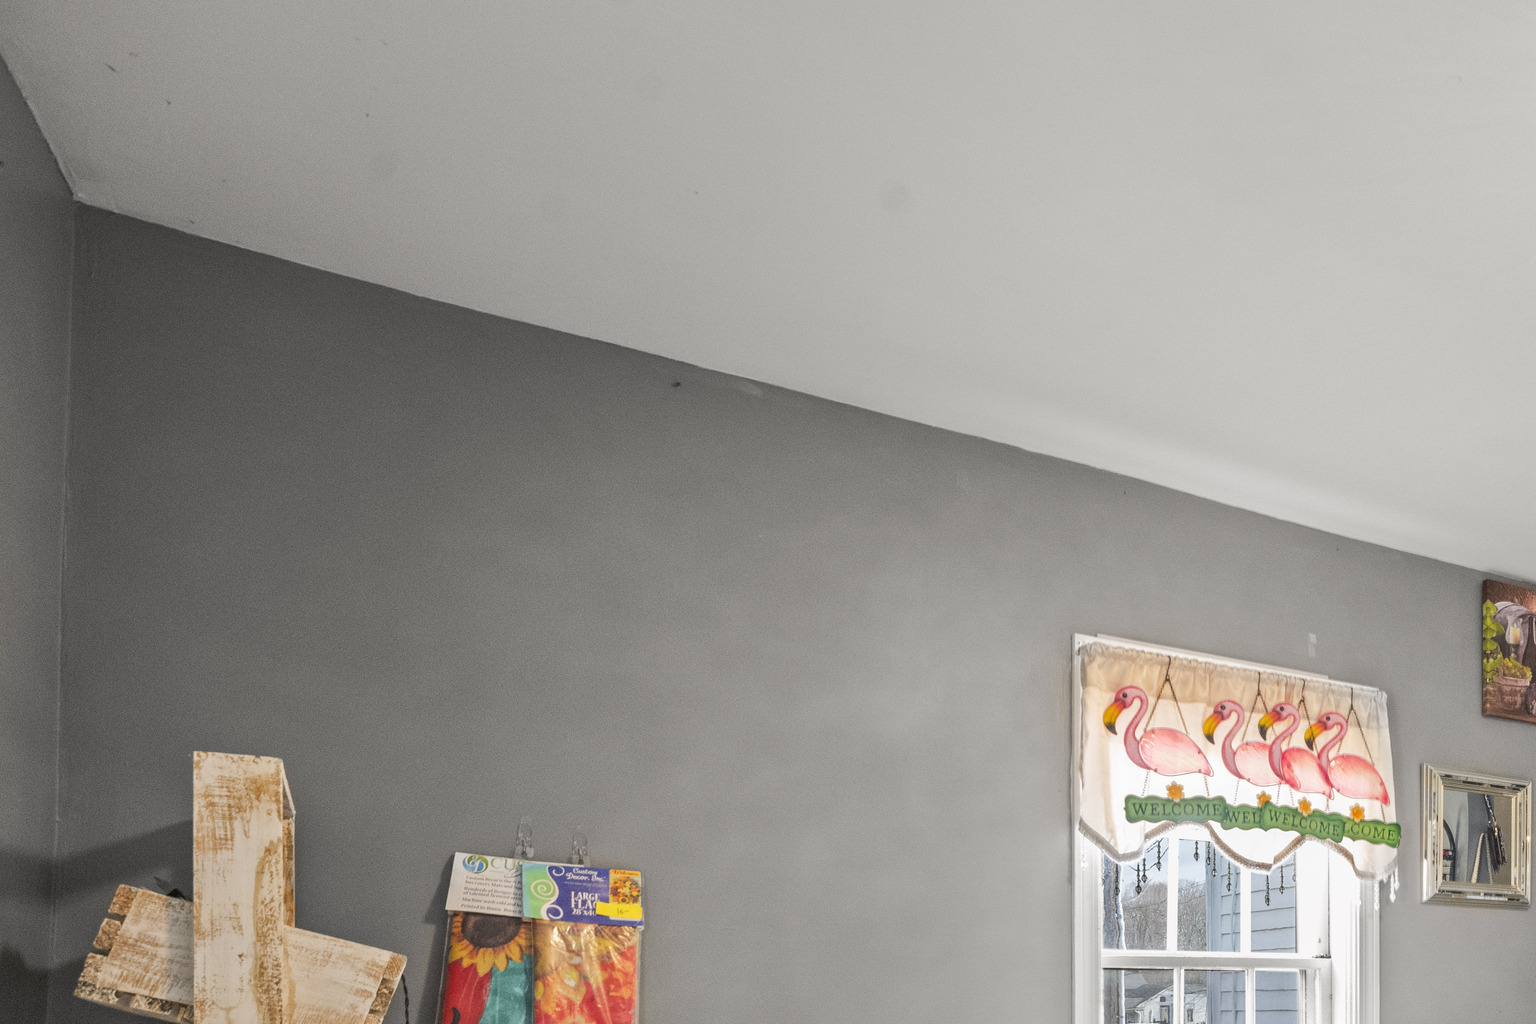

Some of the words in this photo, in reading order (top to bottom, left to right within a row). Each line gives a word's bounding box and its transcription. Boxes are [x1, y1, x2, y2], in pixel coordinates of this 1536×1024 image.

[1132, 802, 1222, 817] WELCOME
[1268, 809, 1341, 838] WELCOME
[1343, 822, 1396, 842] COME
[571, 891, 600, 901] LARGE
